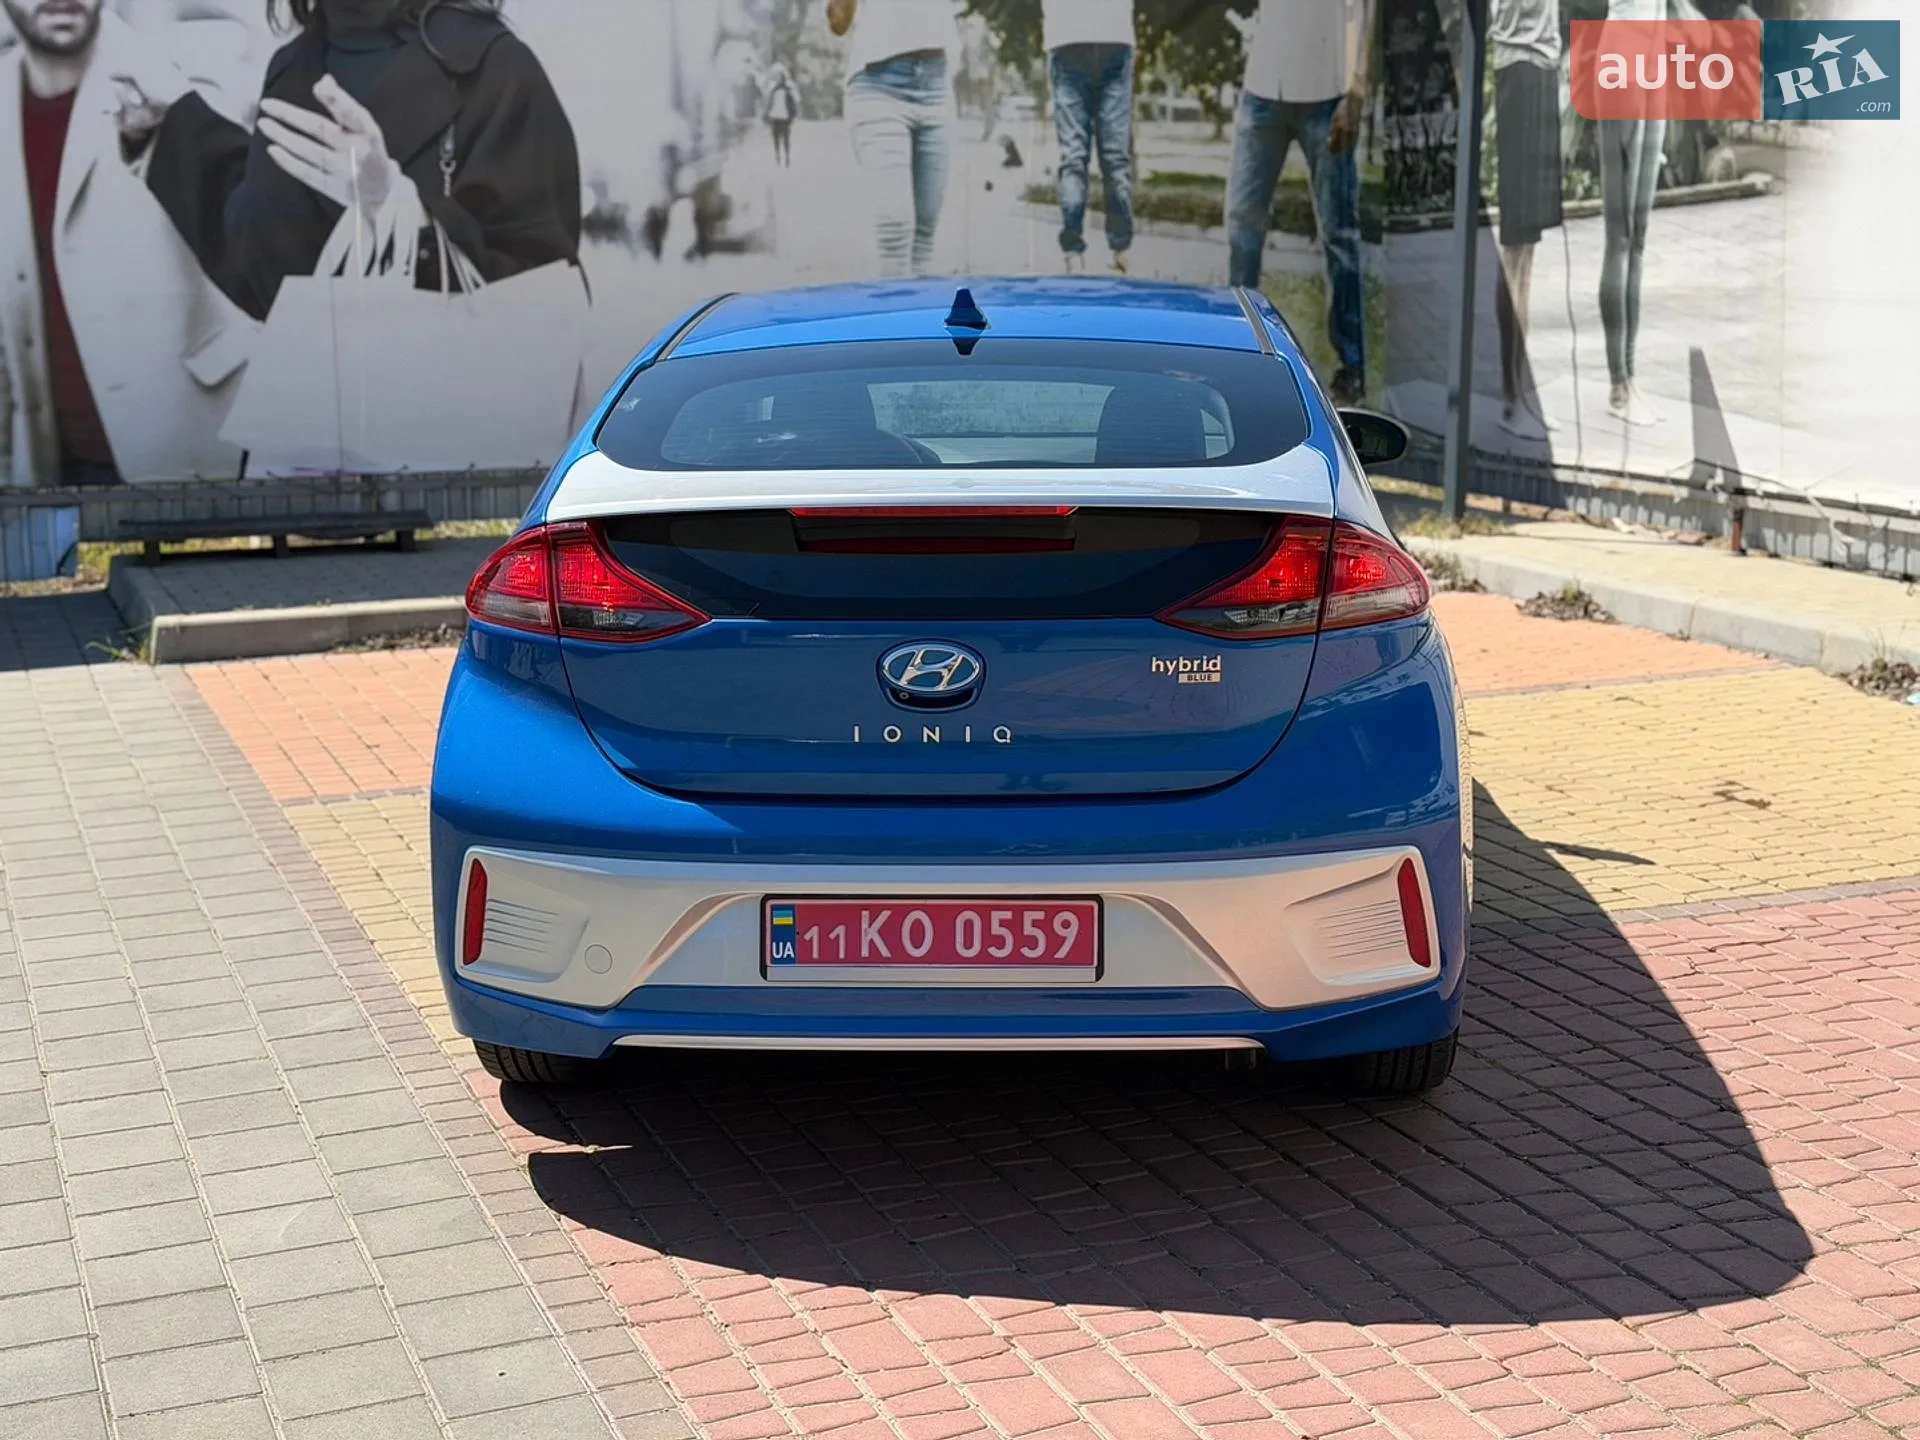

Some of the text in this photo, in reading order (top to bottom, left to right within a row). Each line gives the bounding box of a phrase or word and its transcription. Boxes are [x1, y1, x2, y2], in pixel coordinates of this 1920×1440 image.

[1151, 655, 1221, 676] hybrid
[1186, 673, 1213, 681] BLUE
[853, 725, 1012, 744] IONIQ
[954, 909, 1081, 960] 0559
[772, 941, 796, 959] UA
